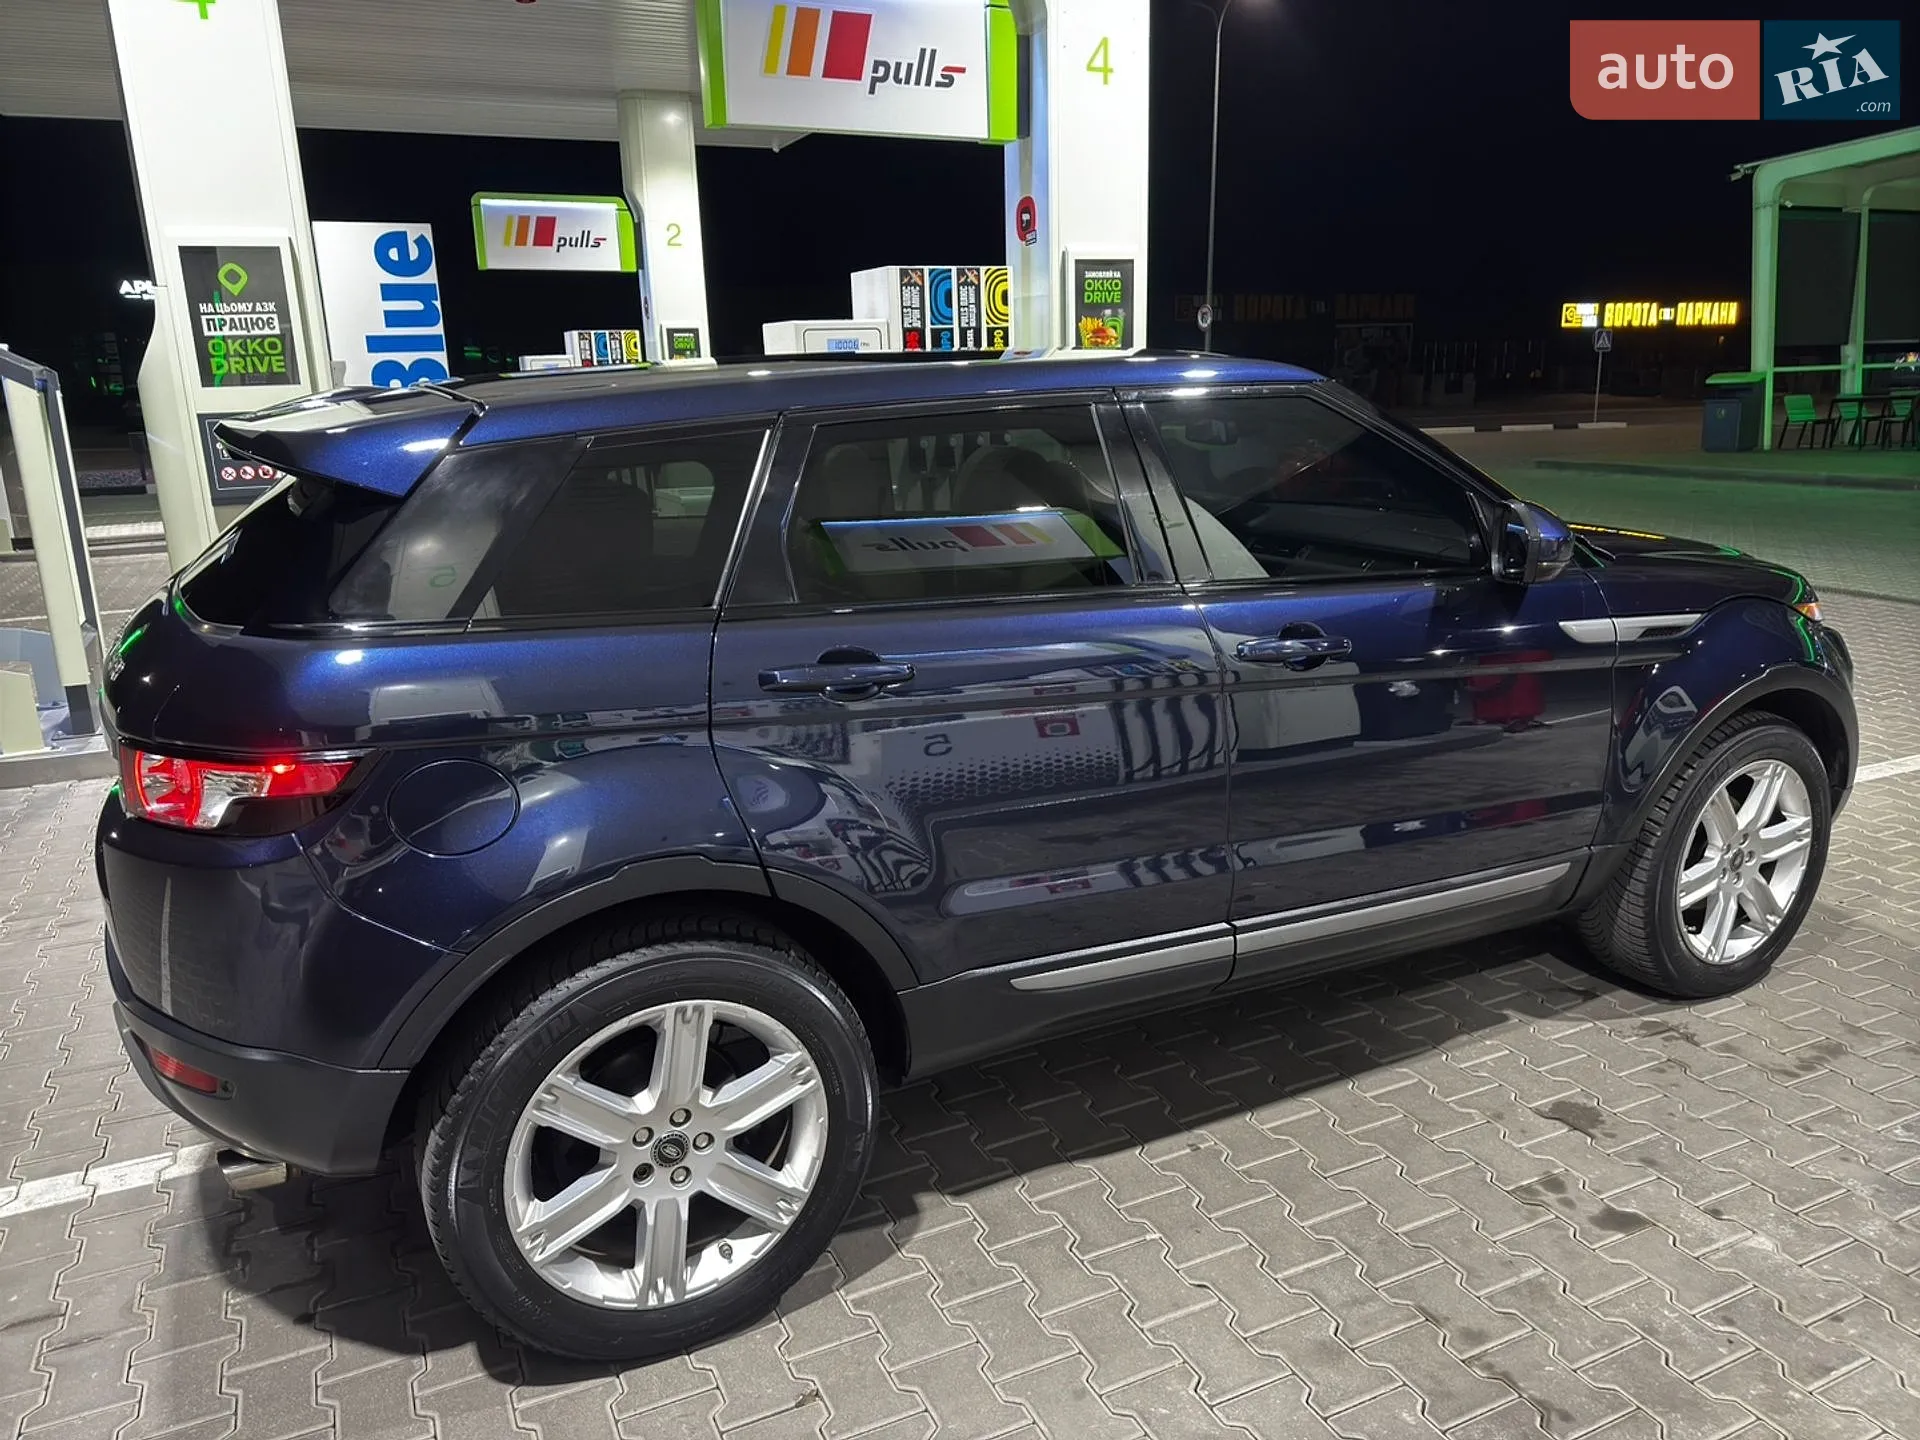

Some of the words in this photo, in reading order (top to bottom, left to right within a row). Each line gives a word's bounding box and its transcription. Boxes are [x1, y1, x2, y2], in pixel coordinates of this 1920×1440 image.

[1086, 36, 1114, 85] 4
[867, 47, 967, 95] pulls
[556, 229, 607, 253] pulls
[666, 223, 682, 247] 2
[1084, 279, 1122, 291] OKKO
[1084, 291, 1121, 303] DRIVE
[199, 302, 215, 313] НА
[214, 302, 254, 314] ЦЬОМУ
[255, 302, 277, 312] АЗК
[1603, 302, 1658, 327] ВОРОТА
[205, 316, 277, 333] ПРАЦЮЄ
[207, 337, 283, 355] OKKO
[210, 355, 286, 374] DRIVE
